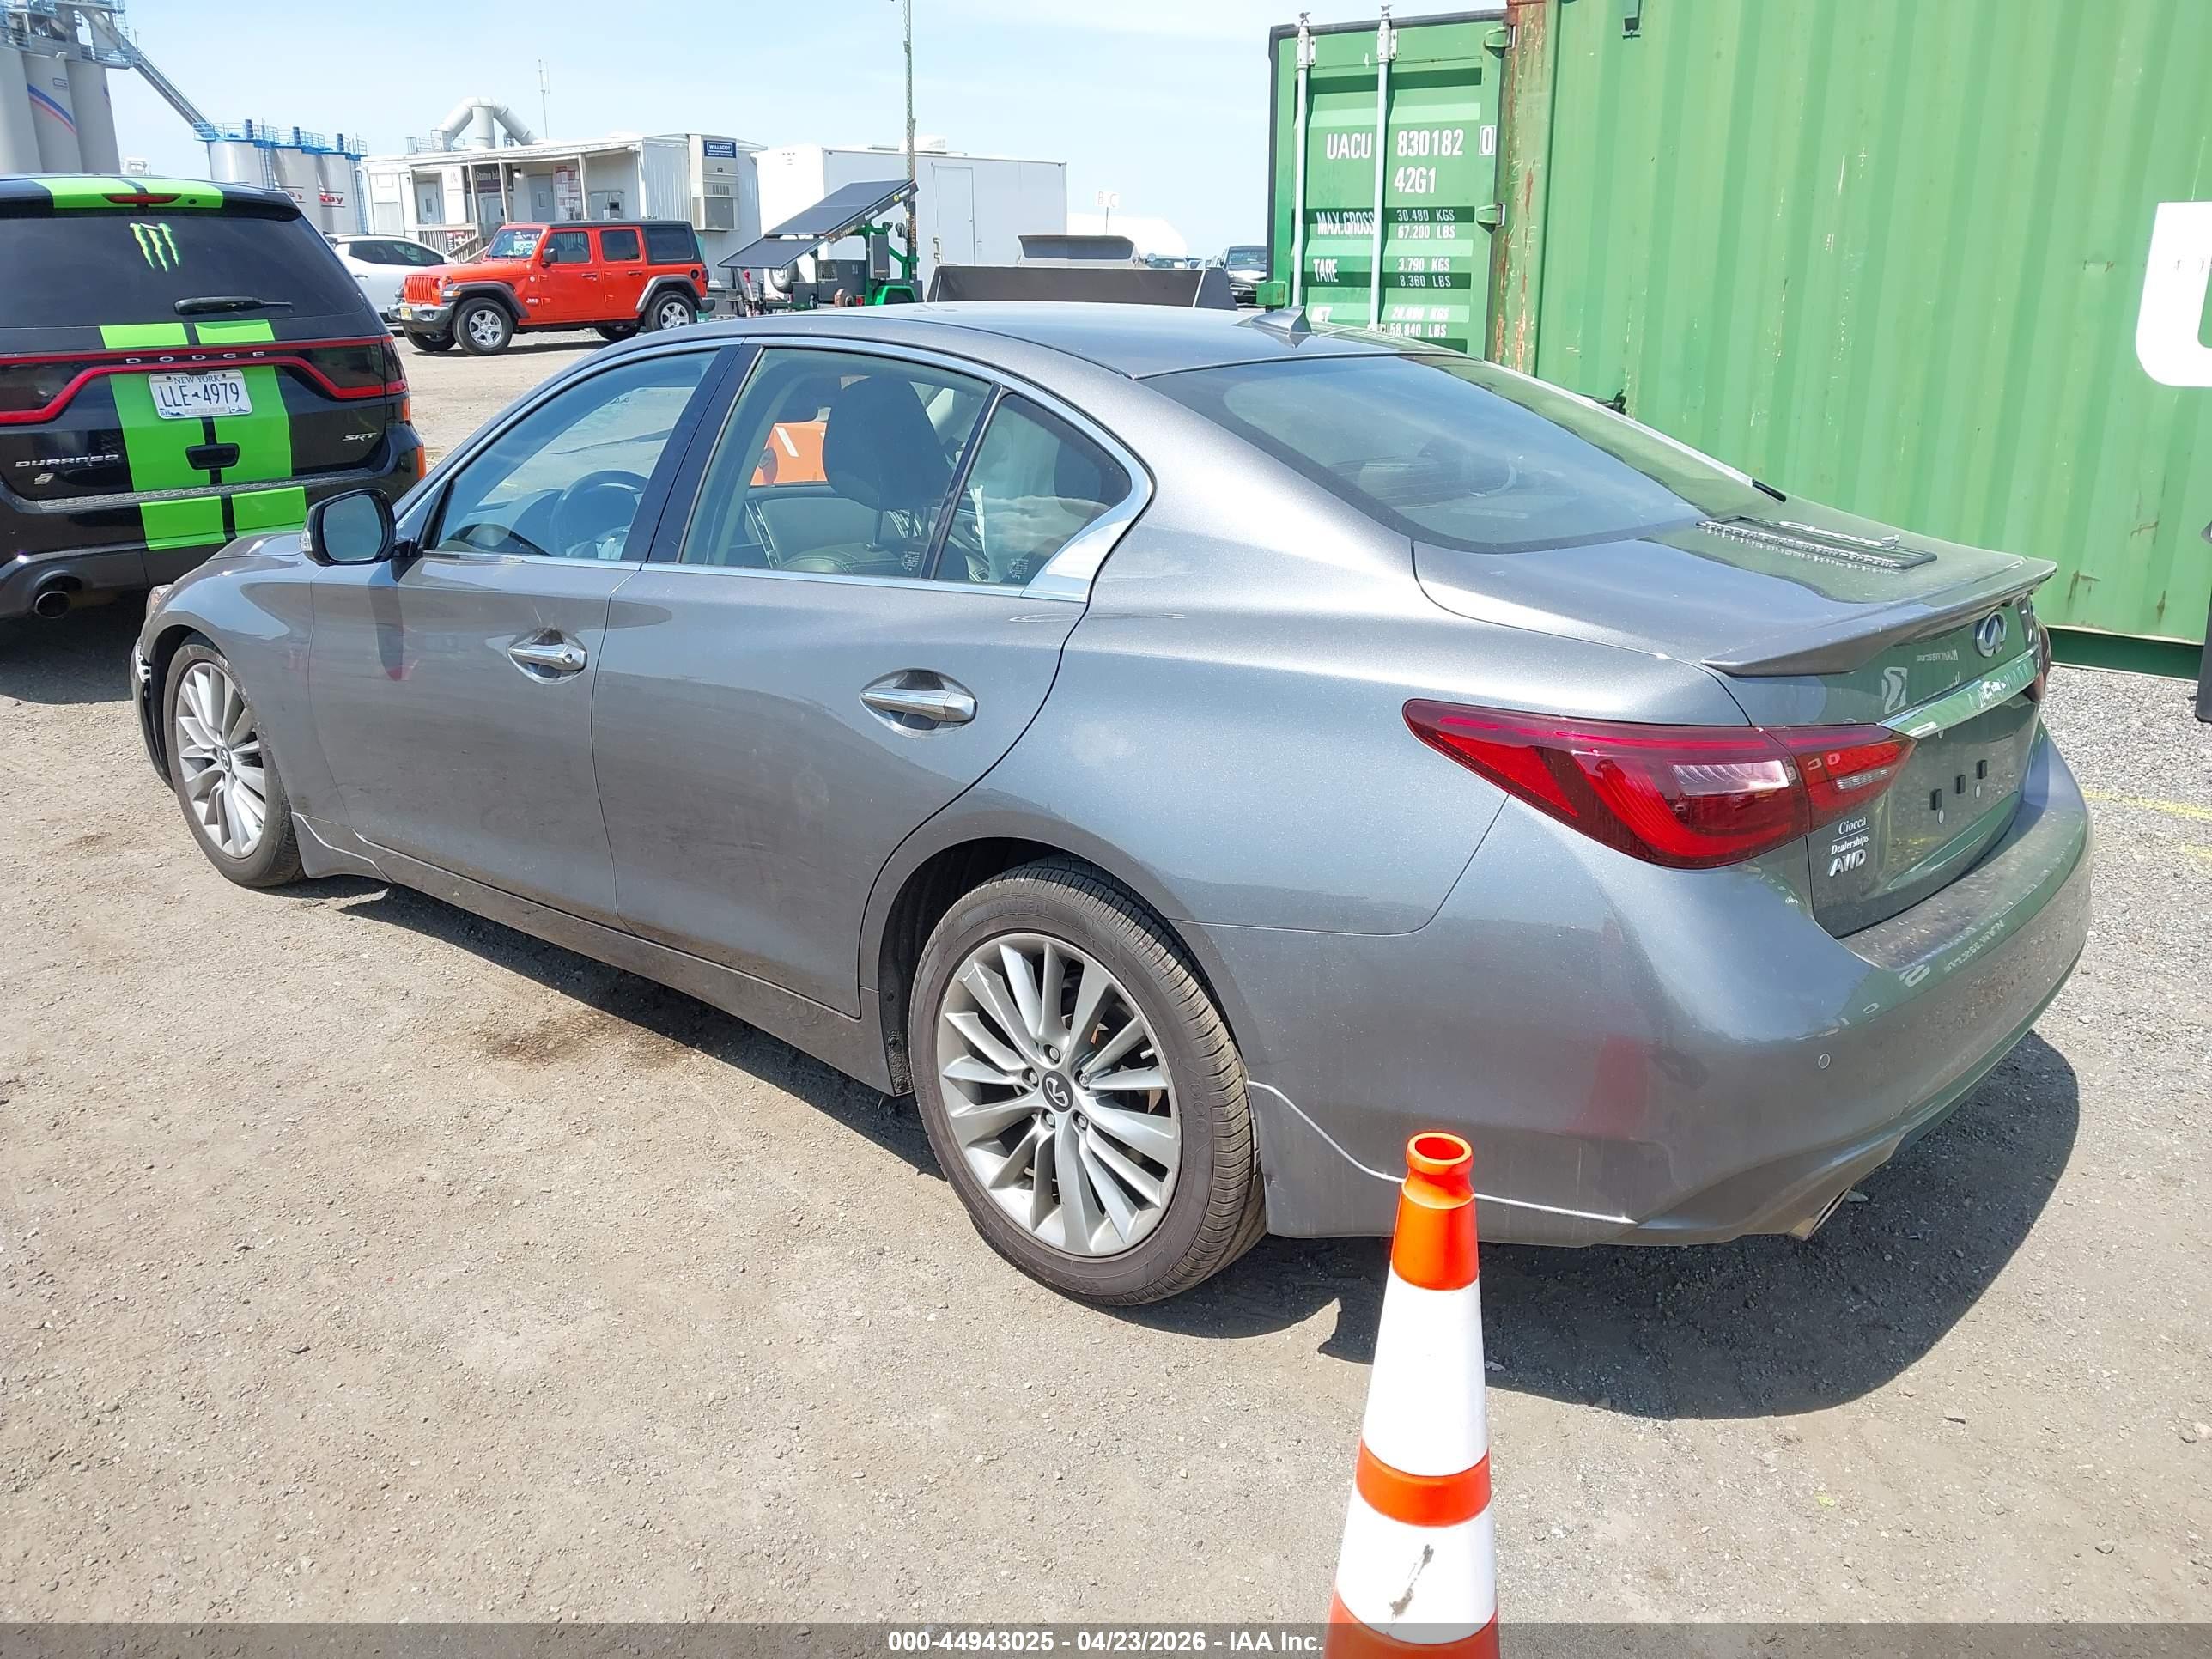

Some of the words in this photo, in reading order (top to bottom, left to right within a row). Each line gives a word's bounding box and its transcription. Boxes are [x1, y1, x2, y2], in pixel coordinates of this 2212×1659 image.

[1327, 132, 1373, 159] UACU
[1397, 129, 1464, 157] 830182
[1394, 167, 1437, 193] 42G1
[1316, 211, 1375, 235] MAX.GROSS
[1397, 209, 1429, 222] 30.480
[1436, 209, 1455, 222] KGS
[1398, 225, 1430, 239] 67.200
[1437, 225, 1455, 239] LBS
[1313, 258, 1339, 283] TARE
[1398, 258, 1425, 271] 3.790
[1431, 258, 1450, 271] KGS
[1400, 275, 1425, 287] 8.360
[1433, 275, 1451, 287] LBS
[1428, 323, 1447, 337] LBS
[125, 350, 266, 364] DODGE
[174, 376, 194, 385] NEW
[196, 374, 221, 384] YORK
[15, 454, 119, 468] DURANGO
[1838, 817, 1867, 835] Ciocca
[1830, 835, 1869, 856] Dealerships
[1828, 848, 1867, 877] AWD
